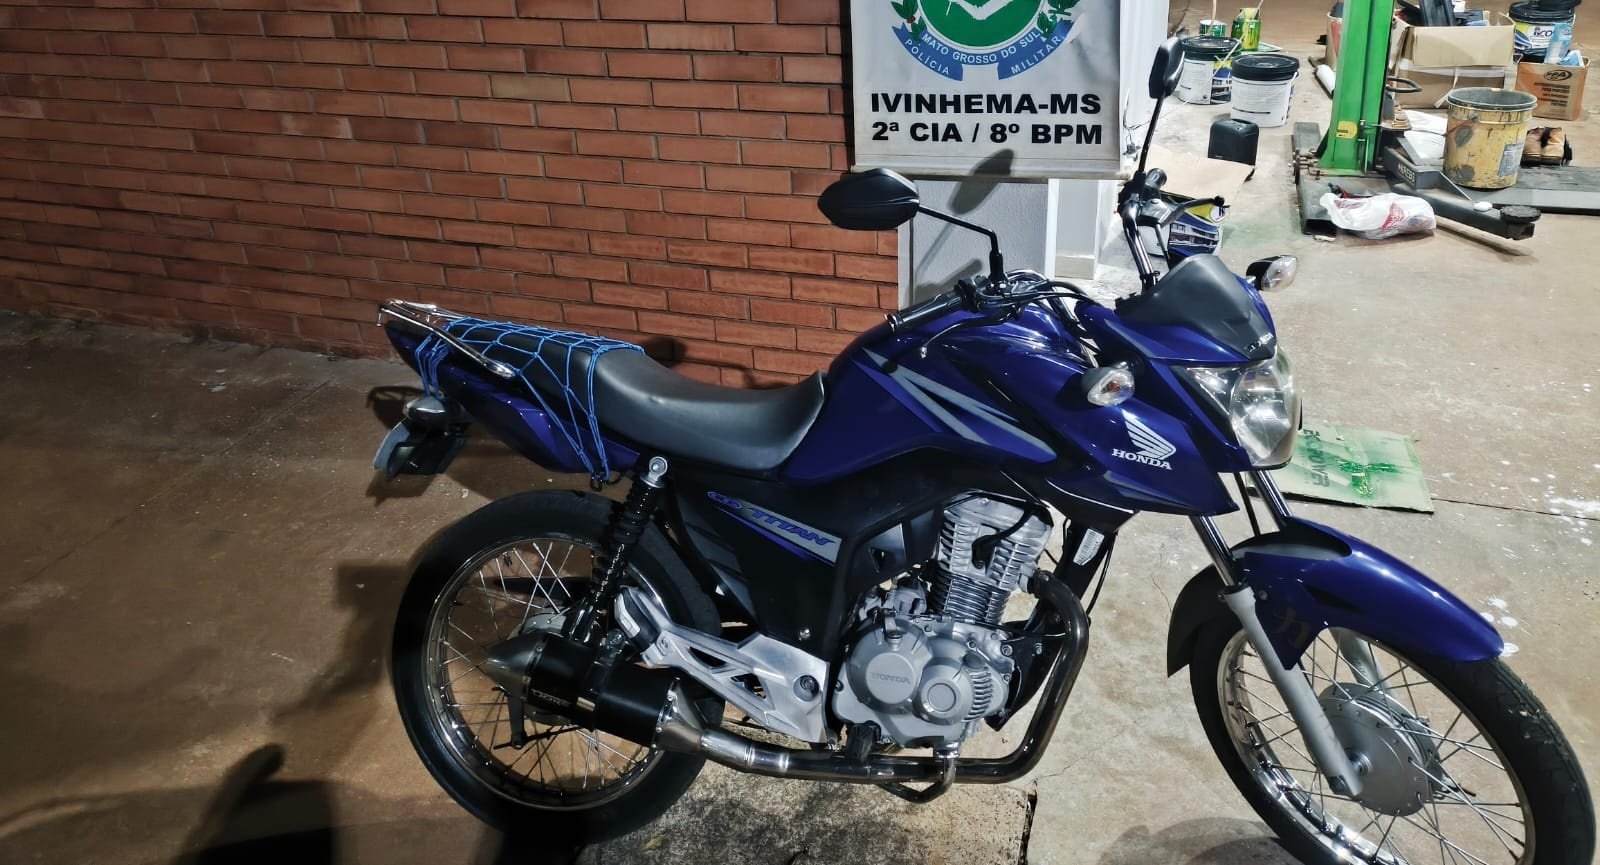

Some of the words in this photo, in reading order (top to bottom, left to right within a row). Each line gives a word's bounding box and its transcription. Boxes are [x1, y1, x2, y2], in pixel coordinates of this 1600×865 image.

[905, 39, 950, 76] POLÍCIA
[1011, 36, 1061, 74] MILITAR
[922, 33, 949, 55] MATO
[952, 51, 997, 65] GROSSO
[1001, 46, 1017, 58] DO
[1019, 31, 1041, 48] SUL
[871, 92, 1102, 115] IVINHEMA-MS
[909, 122, 963, 143] CIA
[971, 122, 980, 143] /
[1031, 124, 1103, 145] BPM
[1111, 448, 1173, 471] HONDA
[746, 506, 837, 547] TITAN
[872, 672, 912, 686] HONDA
